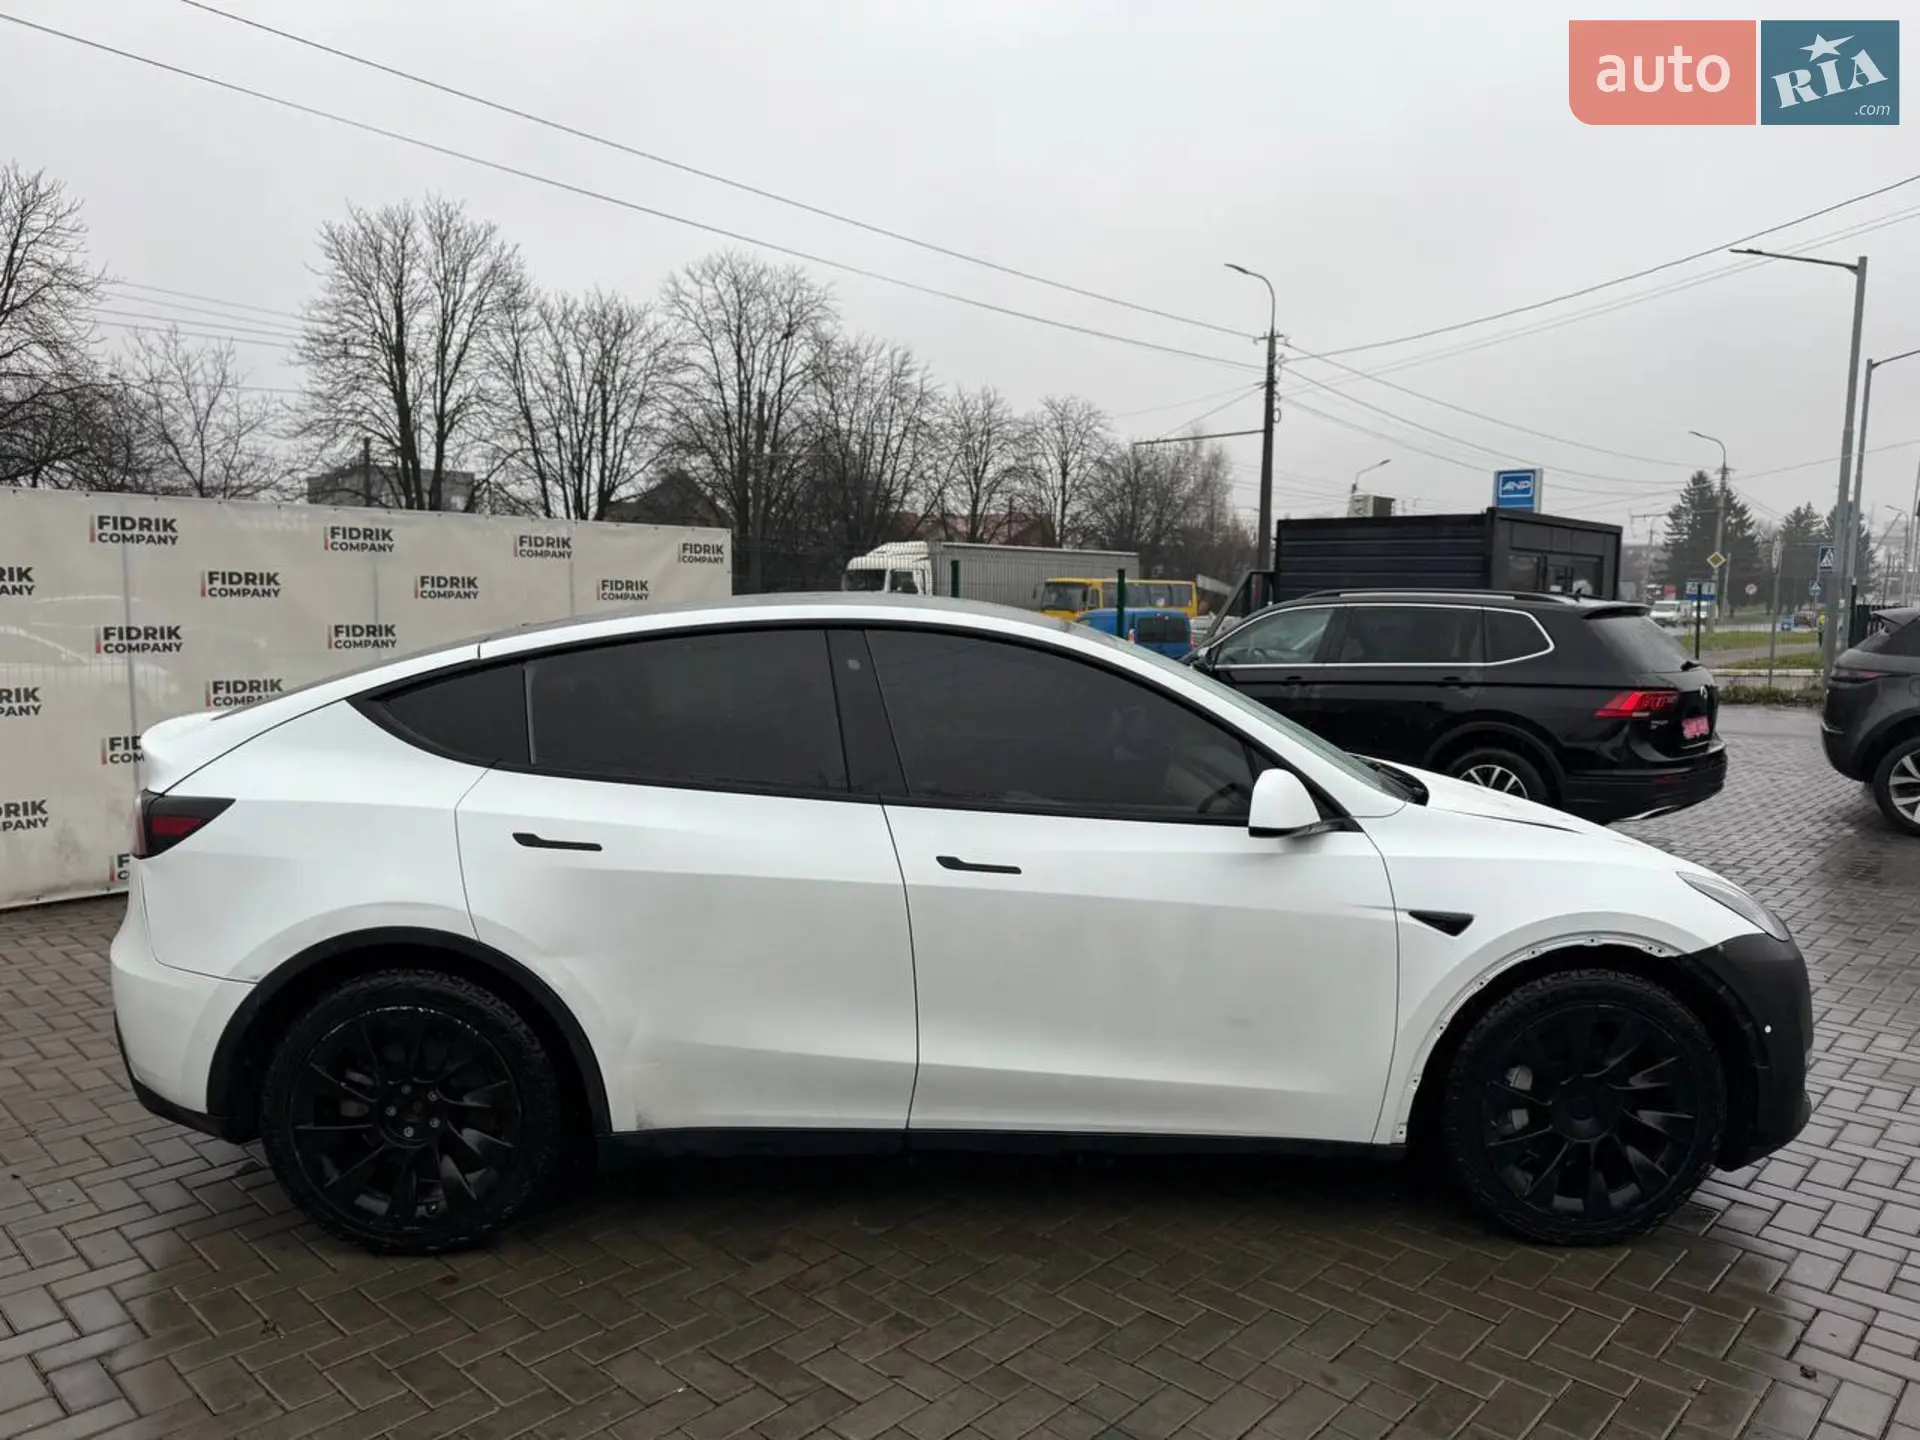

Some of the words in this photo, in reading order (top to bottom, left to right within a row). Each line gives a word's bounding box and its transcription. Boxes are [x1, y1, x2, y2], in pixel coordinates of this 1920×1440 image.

[97, 515, 178, 533] FIDRIK
[97, 532, 179, 546] COMPANY
[330, 526, 394, 542] FIDRIK
[330, 541, 395, 553] COMPANY
[519, 535, 572, 549] FIDRIK
[682, 542, 725, 555] FIDRIK
[519, 548, 573, 559] COMPANY
[682, 554, 725, 564] COMPANY
[207, 571, 281, 587] FIDRIK
[420, 575, 479, 589] FIDRIK
[601, 579, 649, 591] FIDRIK
[207, 587, 281, 598] COMPANY
[420, 589, 479, 600] COMPANY
[601, 591, 649, 600] COMPANY
[103, 625, 182, 642] FIDRIK
[334, 623, 396, 638] FIDRIK
[103, 640, 183, 654] COMPANY
[334, 638, 397, 650] COMPANY
[213, 678, 283, 695] FIDRIK
